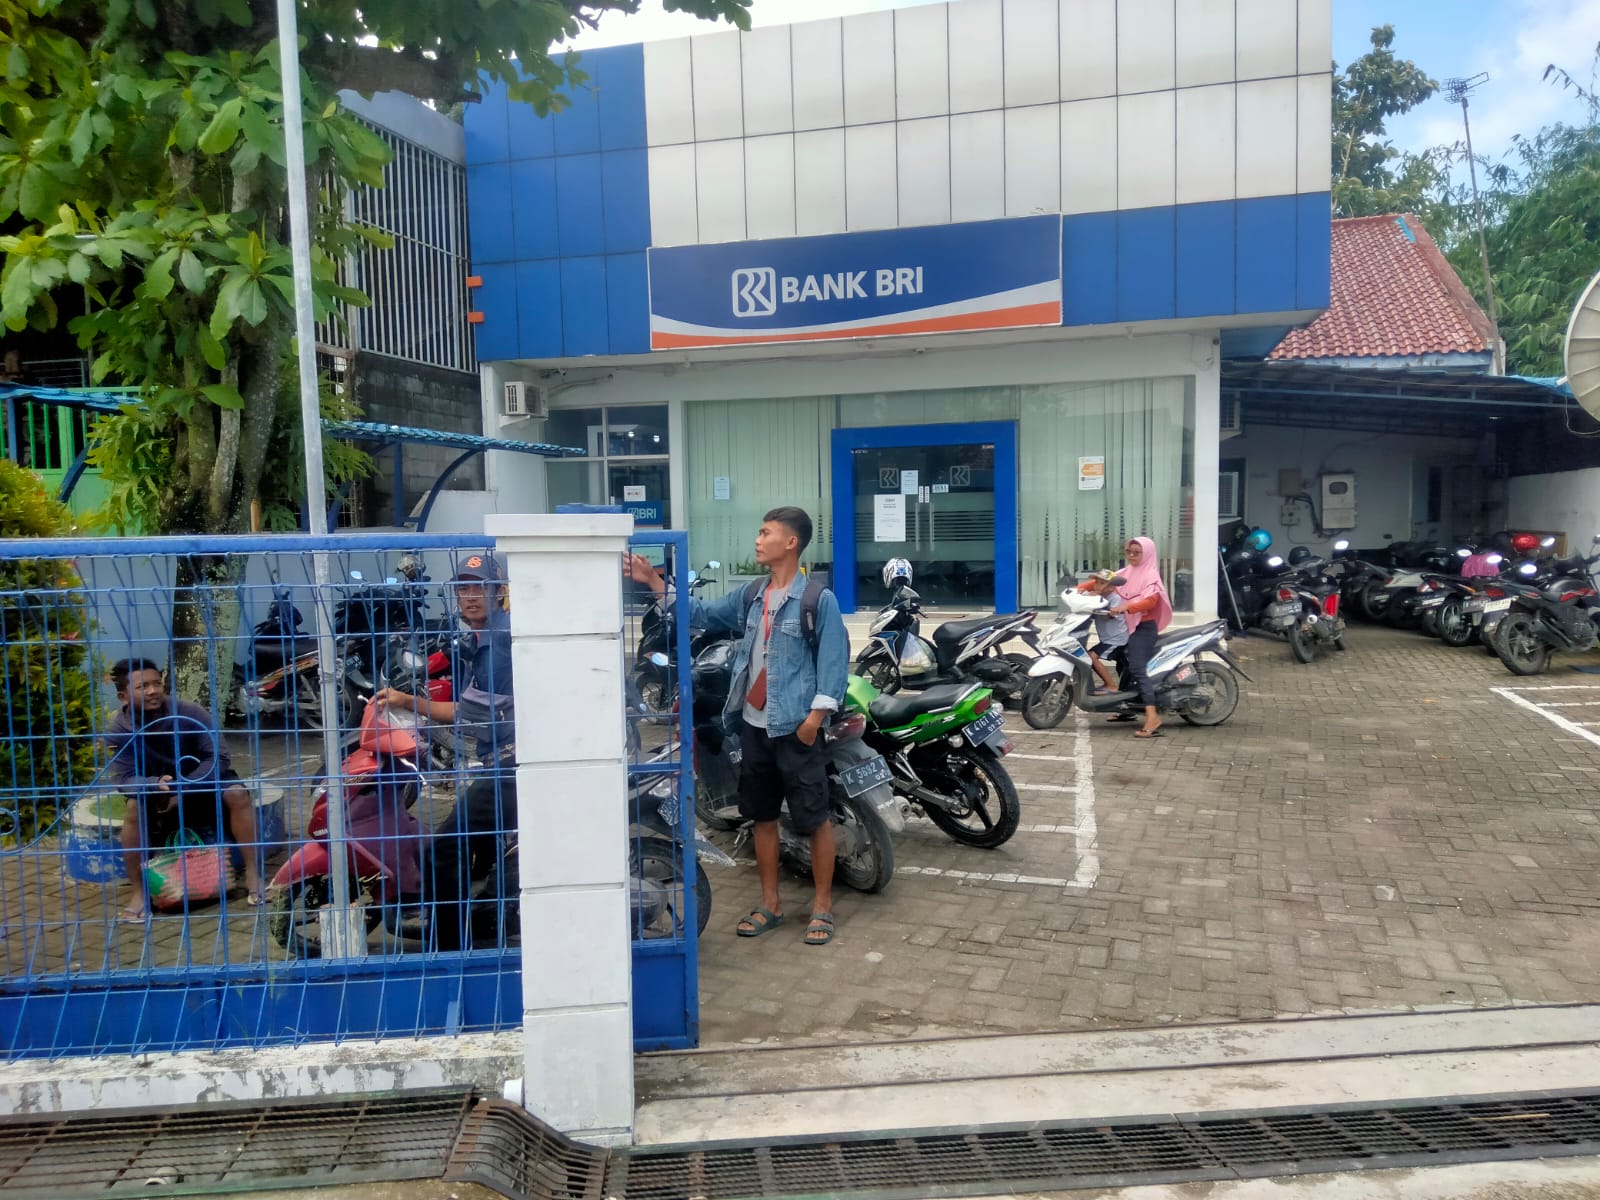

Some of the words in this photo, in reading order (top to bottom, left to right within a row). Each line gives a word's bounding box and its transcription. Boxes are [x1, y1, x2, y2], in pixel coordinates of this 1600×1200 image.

[781, 271, 868, 303] BANK
[876, 266, 923, 296] BRI
[639, 508, 657, 520] BRI
[846, 772, 854, 784] K
[856, 762, 877, 779] 5692
